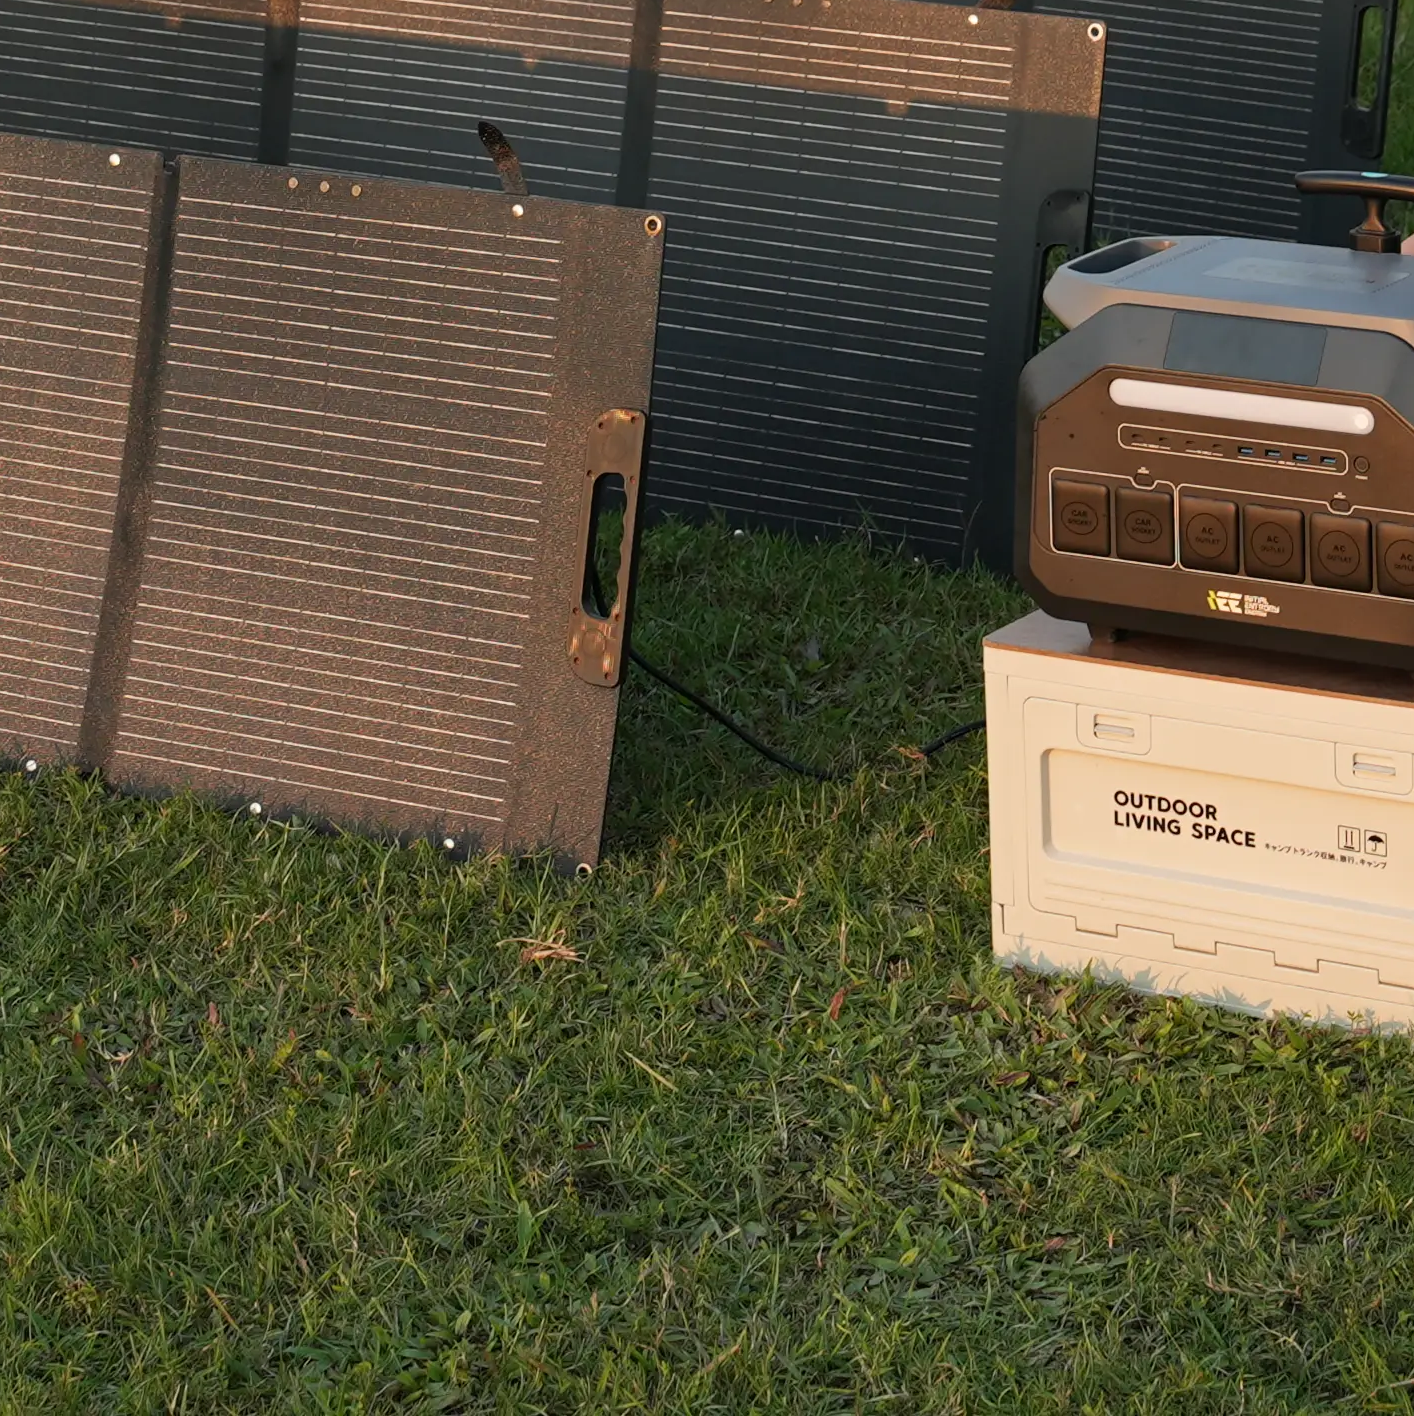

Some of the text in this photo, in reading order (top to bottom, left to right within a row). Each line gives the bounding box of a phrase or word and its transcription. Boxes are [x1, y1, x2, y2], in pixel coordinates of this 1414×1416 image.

[1201, 526, 1214, 535] AC
[1266, 535, 1279, 544] AC
[1333, 545, 1346, 553] AC
[1400, 553, 1413, 562] AC
[1113, 790, 1218, 821] OUTDOOR
[1113, 810, 1256, 848] LIVING SPACE
